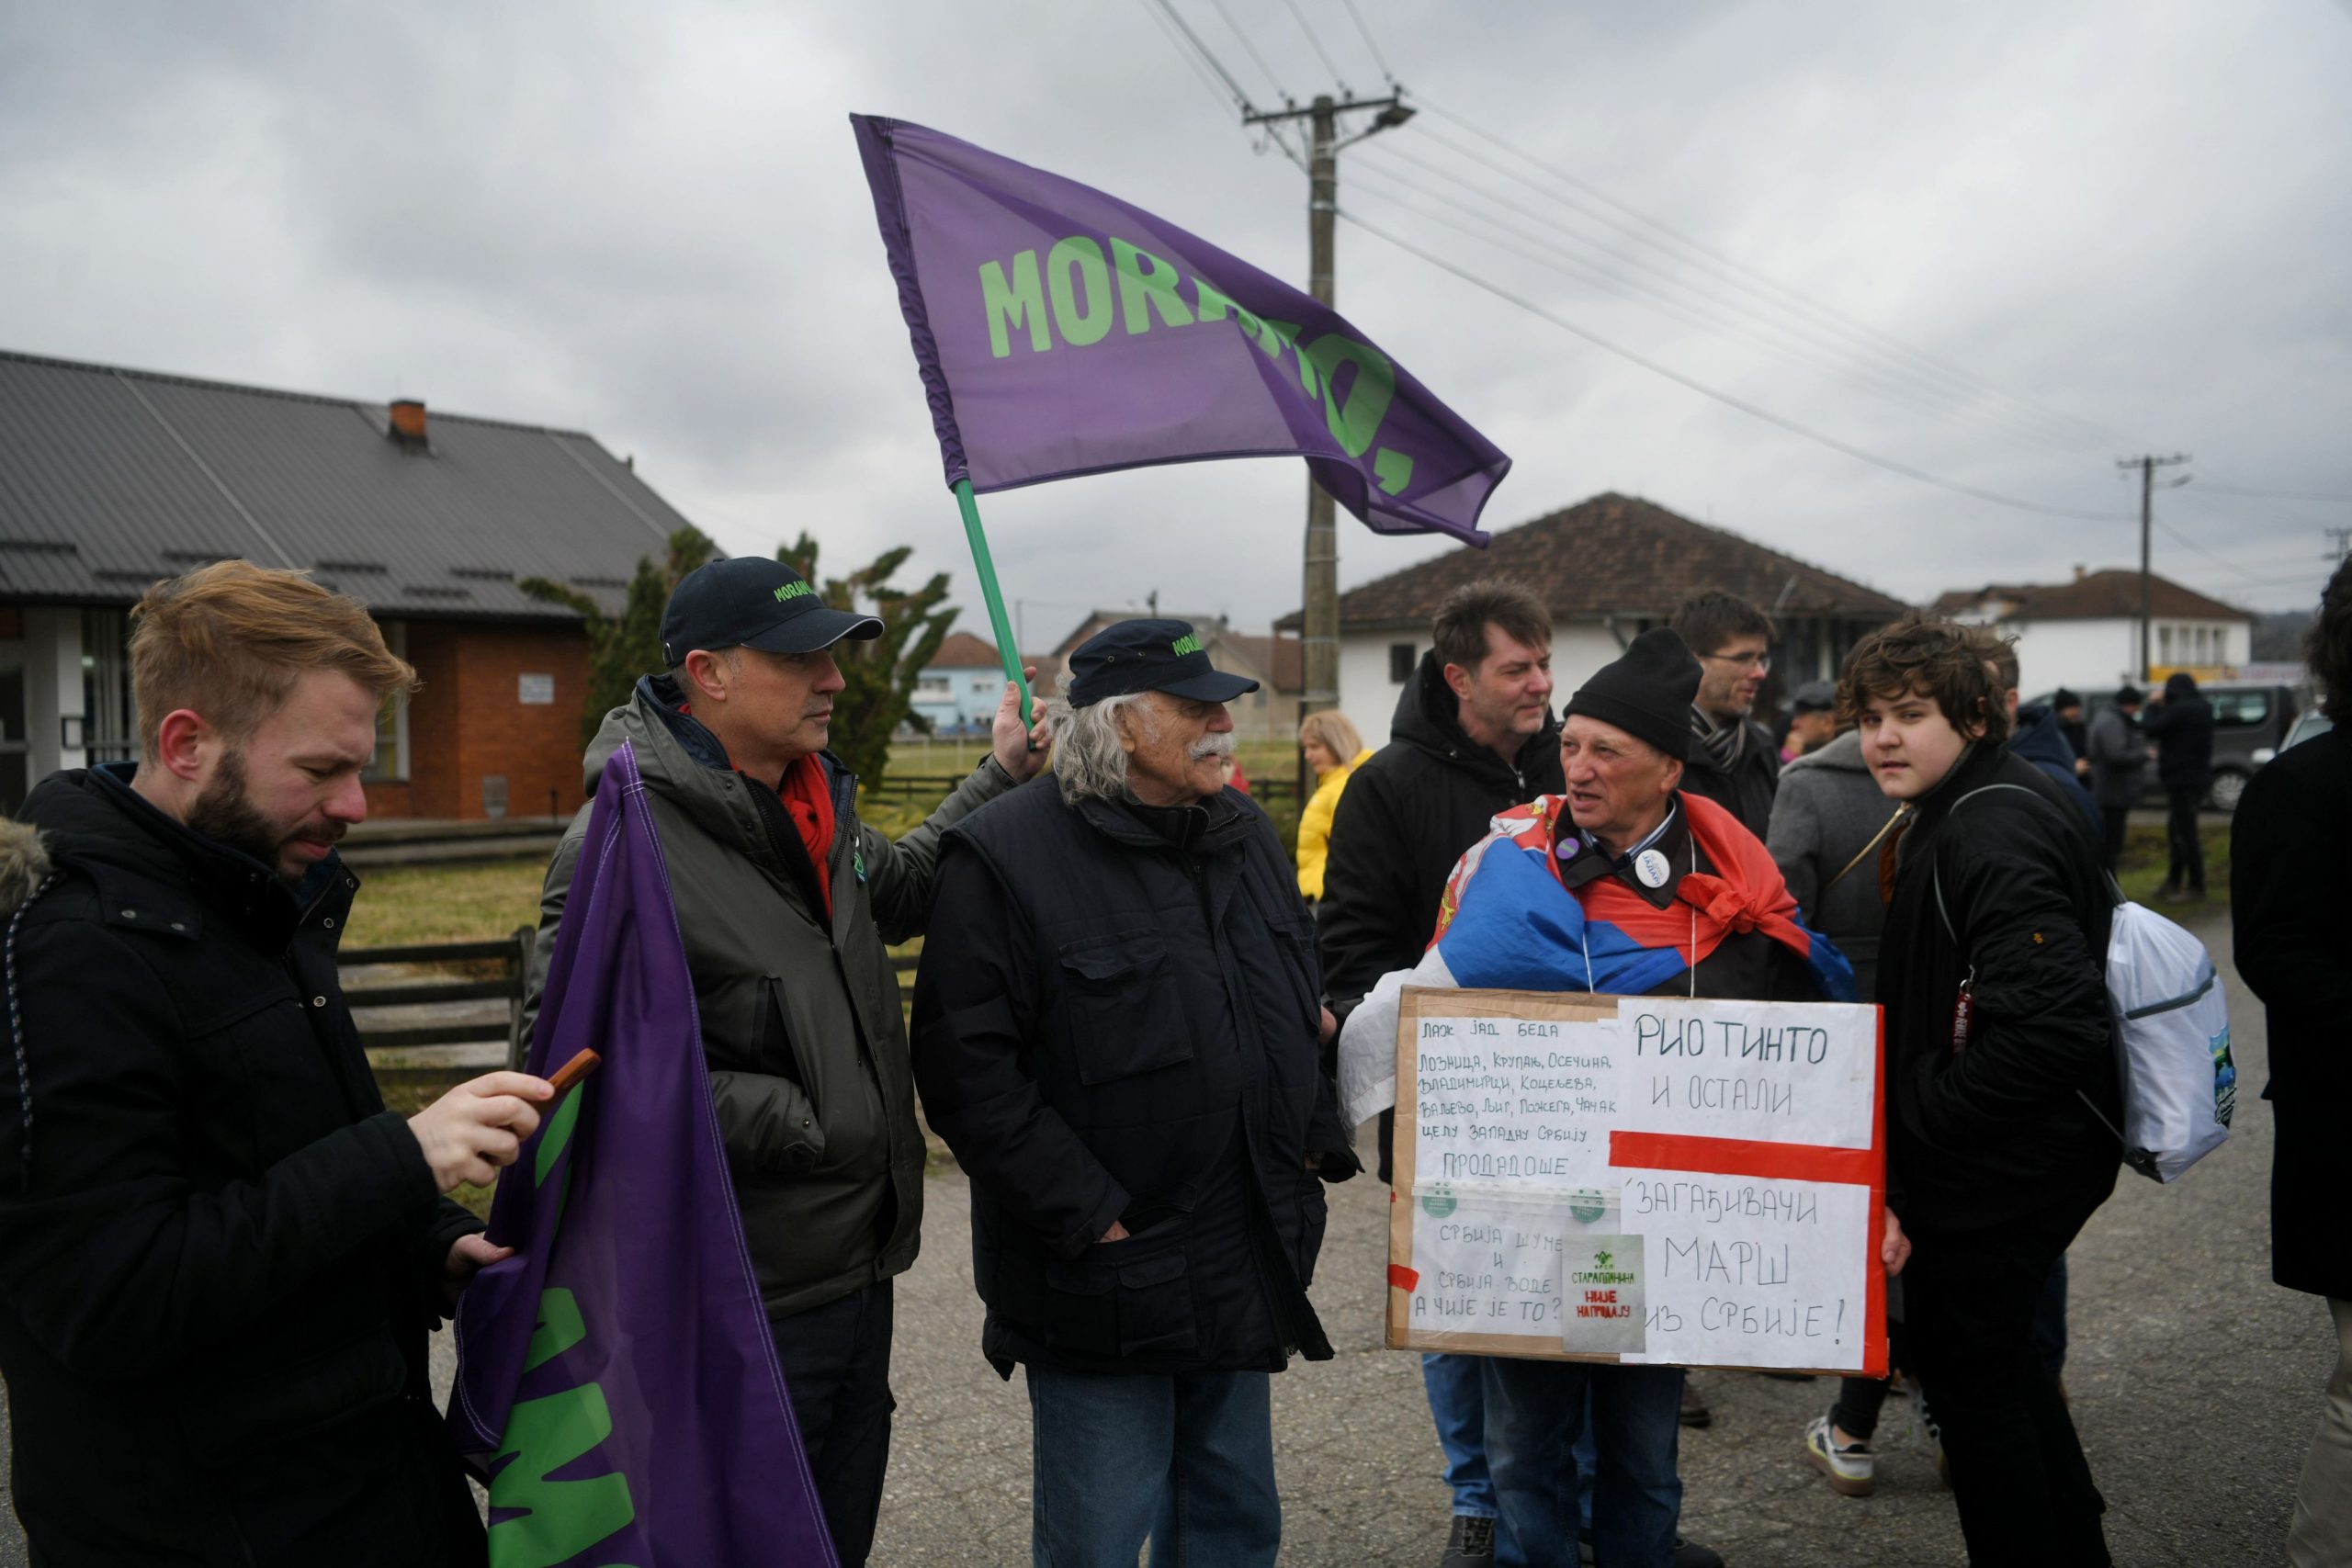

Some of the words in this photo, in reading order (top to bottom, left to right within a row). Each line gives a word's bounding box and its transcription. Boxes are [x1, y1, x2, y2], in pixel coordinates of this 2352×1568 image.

[1422, 1022, 1454, 1038] ЛАЖ
[1470, 1020, 1499, 1036] ЈАД
[1518, 1023, 1559, 1038] БЕДА
[1635, 1013, 1703, 1056] РИО
[1713, 1021, 1827, 1065] ТИНТО
[1419, 1054, 1487, 1072] ЛОЗНИЦА,
[1493, 1052, 1544, 1069] КРУПАЊ,
[1548, 1053, 1611, 1069] ОСЕЧИНА,
[1521, 1075, 1596, 1092] КОЦЕЉЕВА,
[1653, 1076, 1669, 1108] И
[1689, 1076, 1792, 1115] ОСТАЛИ
[1520, 1099, 1574, 1116] ПОЖЕГА,
[1575, 1097, 1617, 1113] ЧАЧАК
[1422, 1125, 1458, 1141] ЦЕЛУ
[1469, 1124, 1529, 1142] ЗАПАДНУ
[1538, 1125, 1587, 1143] СРБИЈУ
[1443, 1153, 1569, 1178] ПРОДАДОШЕ
[1636, 1181, 1816, 1224] ЗАГАЂИВАЧИ
[1440, 1225, 1503, 1244] СРБИЈА
[1494, 1252, 1504, 1269] И
[1665, 1236, 1789, 1286] МАРШ
[1439, 1271, 1493, 1289] СРБИЈА
[1505, 1276, 1551, 1294] ВОДЕ
[1416, 1296, 1426, 1316] А
[1434, 1294, 1477, 1316] ЧИЈЕ
[1487, 1297, 1507, 1317] ЈЕ
[1585, 1290, 1617, 1303] НИЈЕ
[1644, 1305, 1682, 1332] ИЗ
